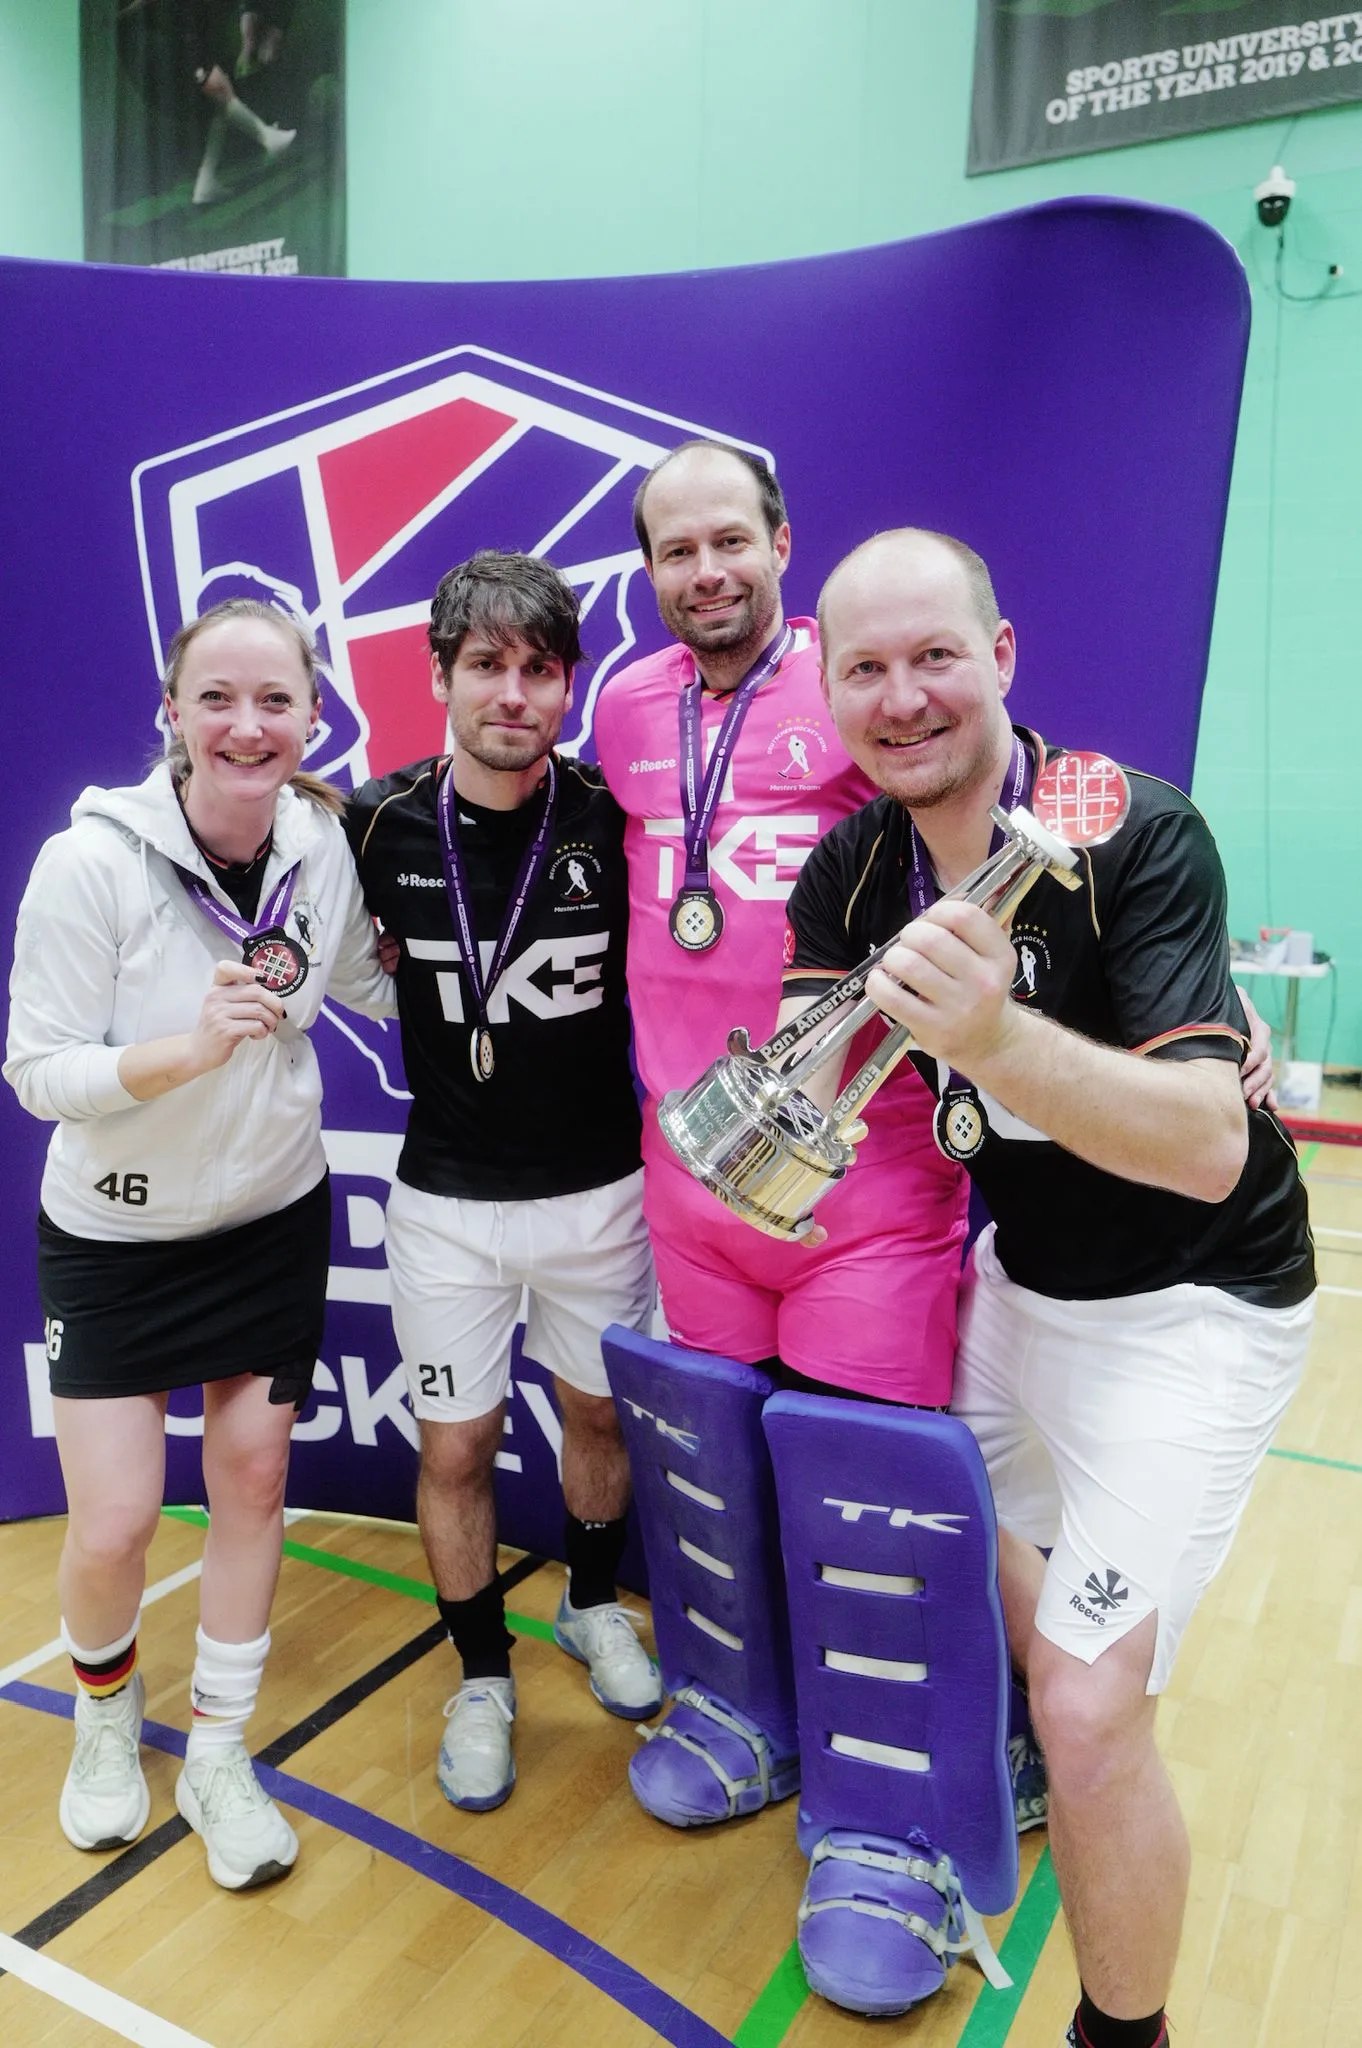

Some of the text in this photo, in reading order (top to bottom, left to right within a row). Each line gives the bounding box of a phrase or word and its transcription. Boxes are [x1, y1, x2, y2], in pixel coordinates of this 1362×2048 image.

[1046, 94, 1086, 125] OF
[1084, 80, 1152, 117] THE
[1154, 63, 1237, 101] YEAR
[1239, 51, 1306, 85] 2019
[1307, 46, 1330, 71] &
[1065, 49, 1180, 95] SPORTS
[640, 759, 677, 773] Reece
[410, 873, 446, 888] Reec
[643, 815, 819, 901] TKE
[405, 930, 610, 1024] TKE
[760, 977, 864, 1061] Pan America
[833, 1064, 882, 1122] Europe
[93, 1172, 149, 1206] 46
[418, 1363, 456, 1398] 21
[622, 1397, 701, 1458] TK
[823, 1497, 971, 1535] TK
[1068, 1593, 1107, 1627] Reece
